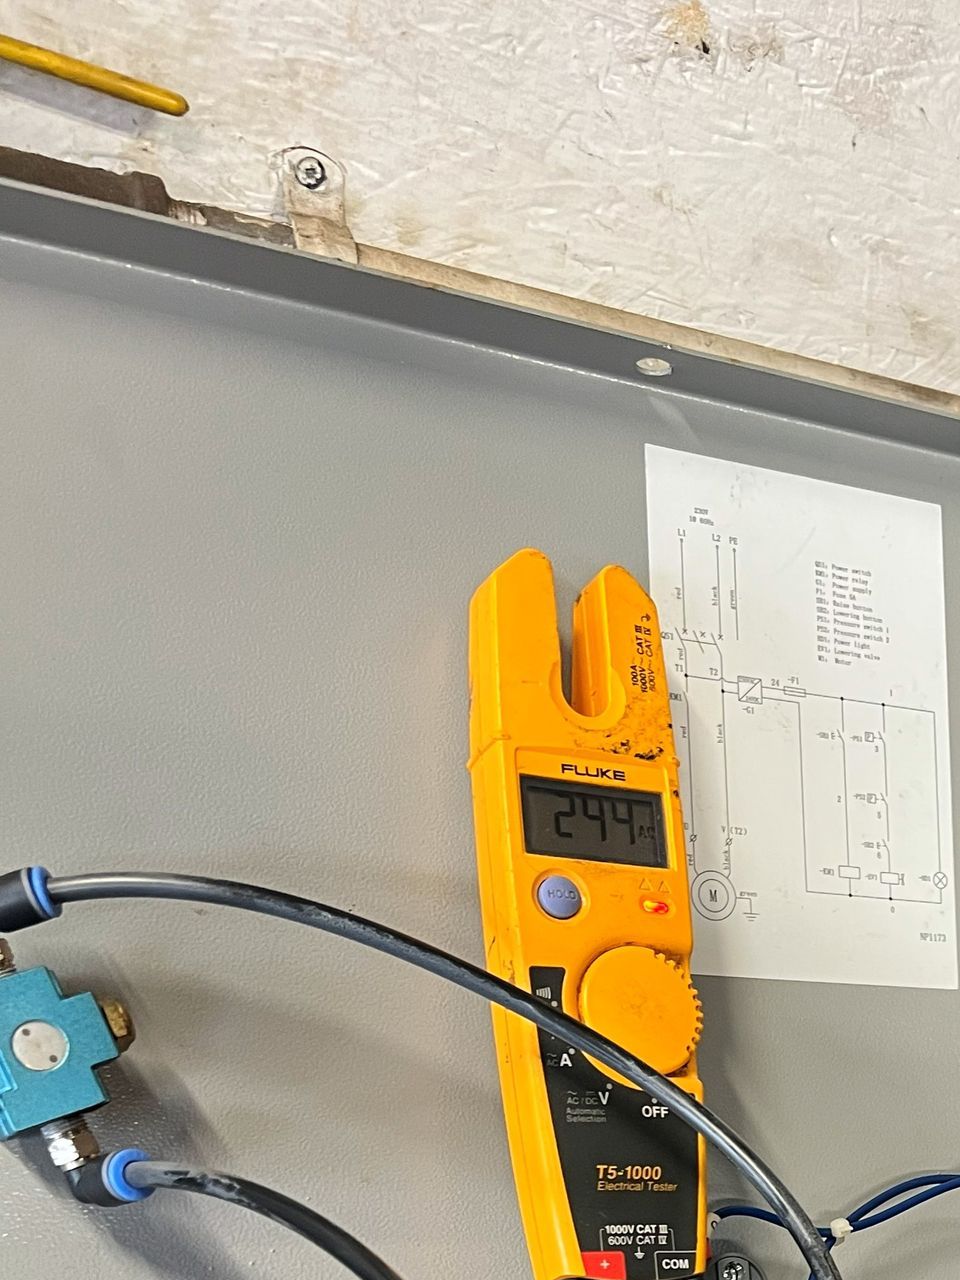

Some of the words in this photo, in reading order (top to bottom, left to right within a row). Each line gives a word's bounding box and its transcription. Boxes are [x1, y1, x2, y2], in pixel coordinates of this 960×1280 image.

[677, 528, 686, 537] L1
[712, 533, 721, 542] L2
[728, 536, 738, 545] PE
[636, 635, 645, 655] CAT
[644, 638, 653, 657] CAT
[675, 663, 684, 672] T1
[709, 667, 718, 676] T2
[561, 763, 626, 781] FLUKE
[554, 791, 636, 845] 244
[709, 889, 718, 902] M
[560, 1053, 573, 1067] A
[598, 1091, 610, 1105] V
[566, 1107, 606, 1116] Automatic
[641, 1105, 669, 1118] OFF
[566, 1114, 607, 1123] Selection
[596, 1165, 662, 1180] T5-1000
[597, 1181, 645, 1191] Electrical
[647, 1181, 678, 1192] Tester
[604, 1225, 635, 1235] 1000V
[636, 1224, 657, 1234] CAT
[607, 1235, 633, 1246] 600V
[636, 1235, 655, 1245] CAT
[661, 1259, 689, 1270] COM
